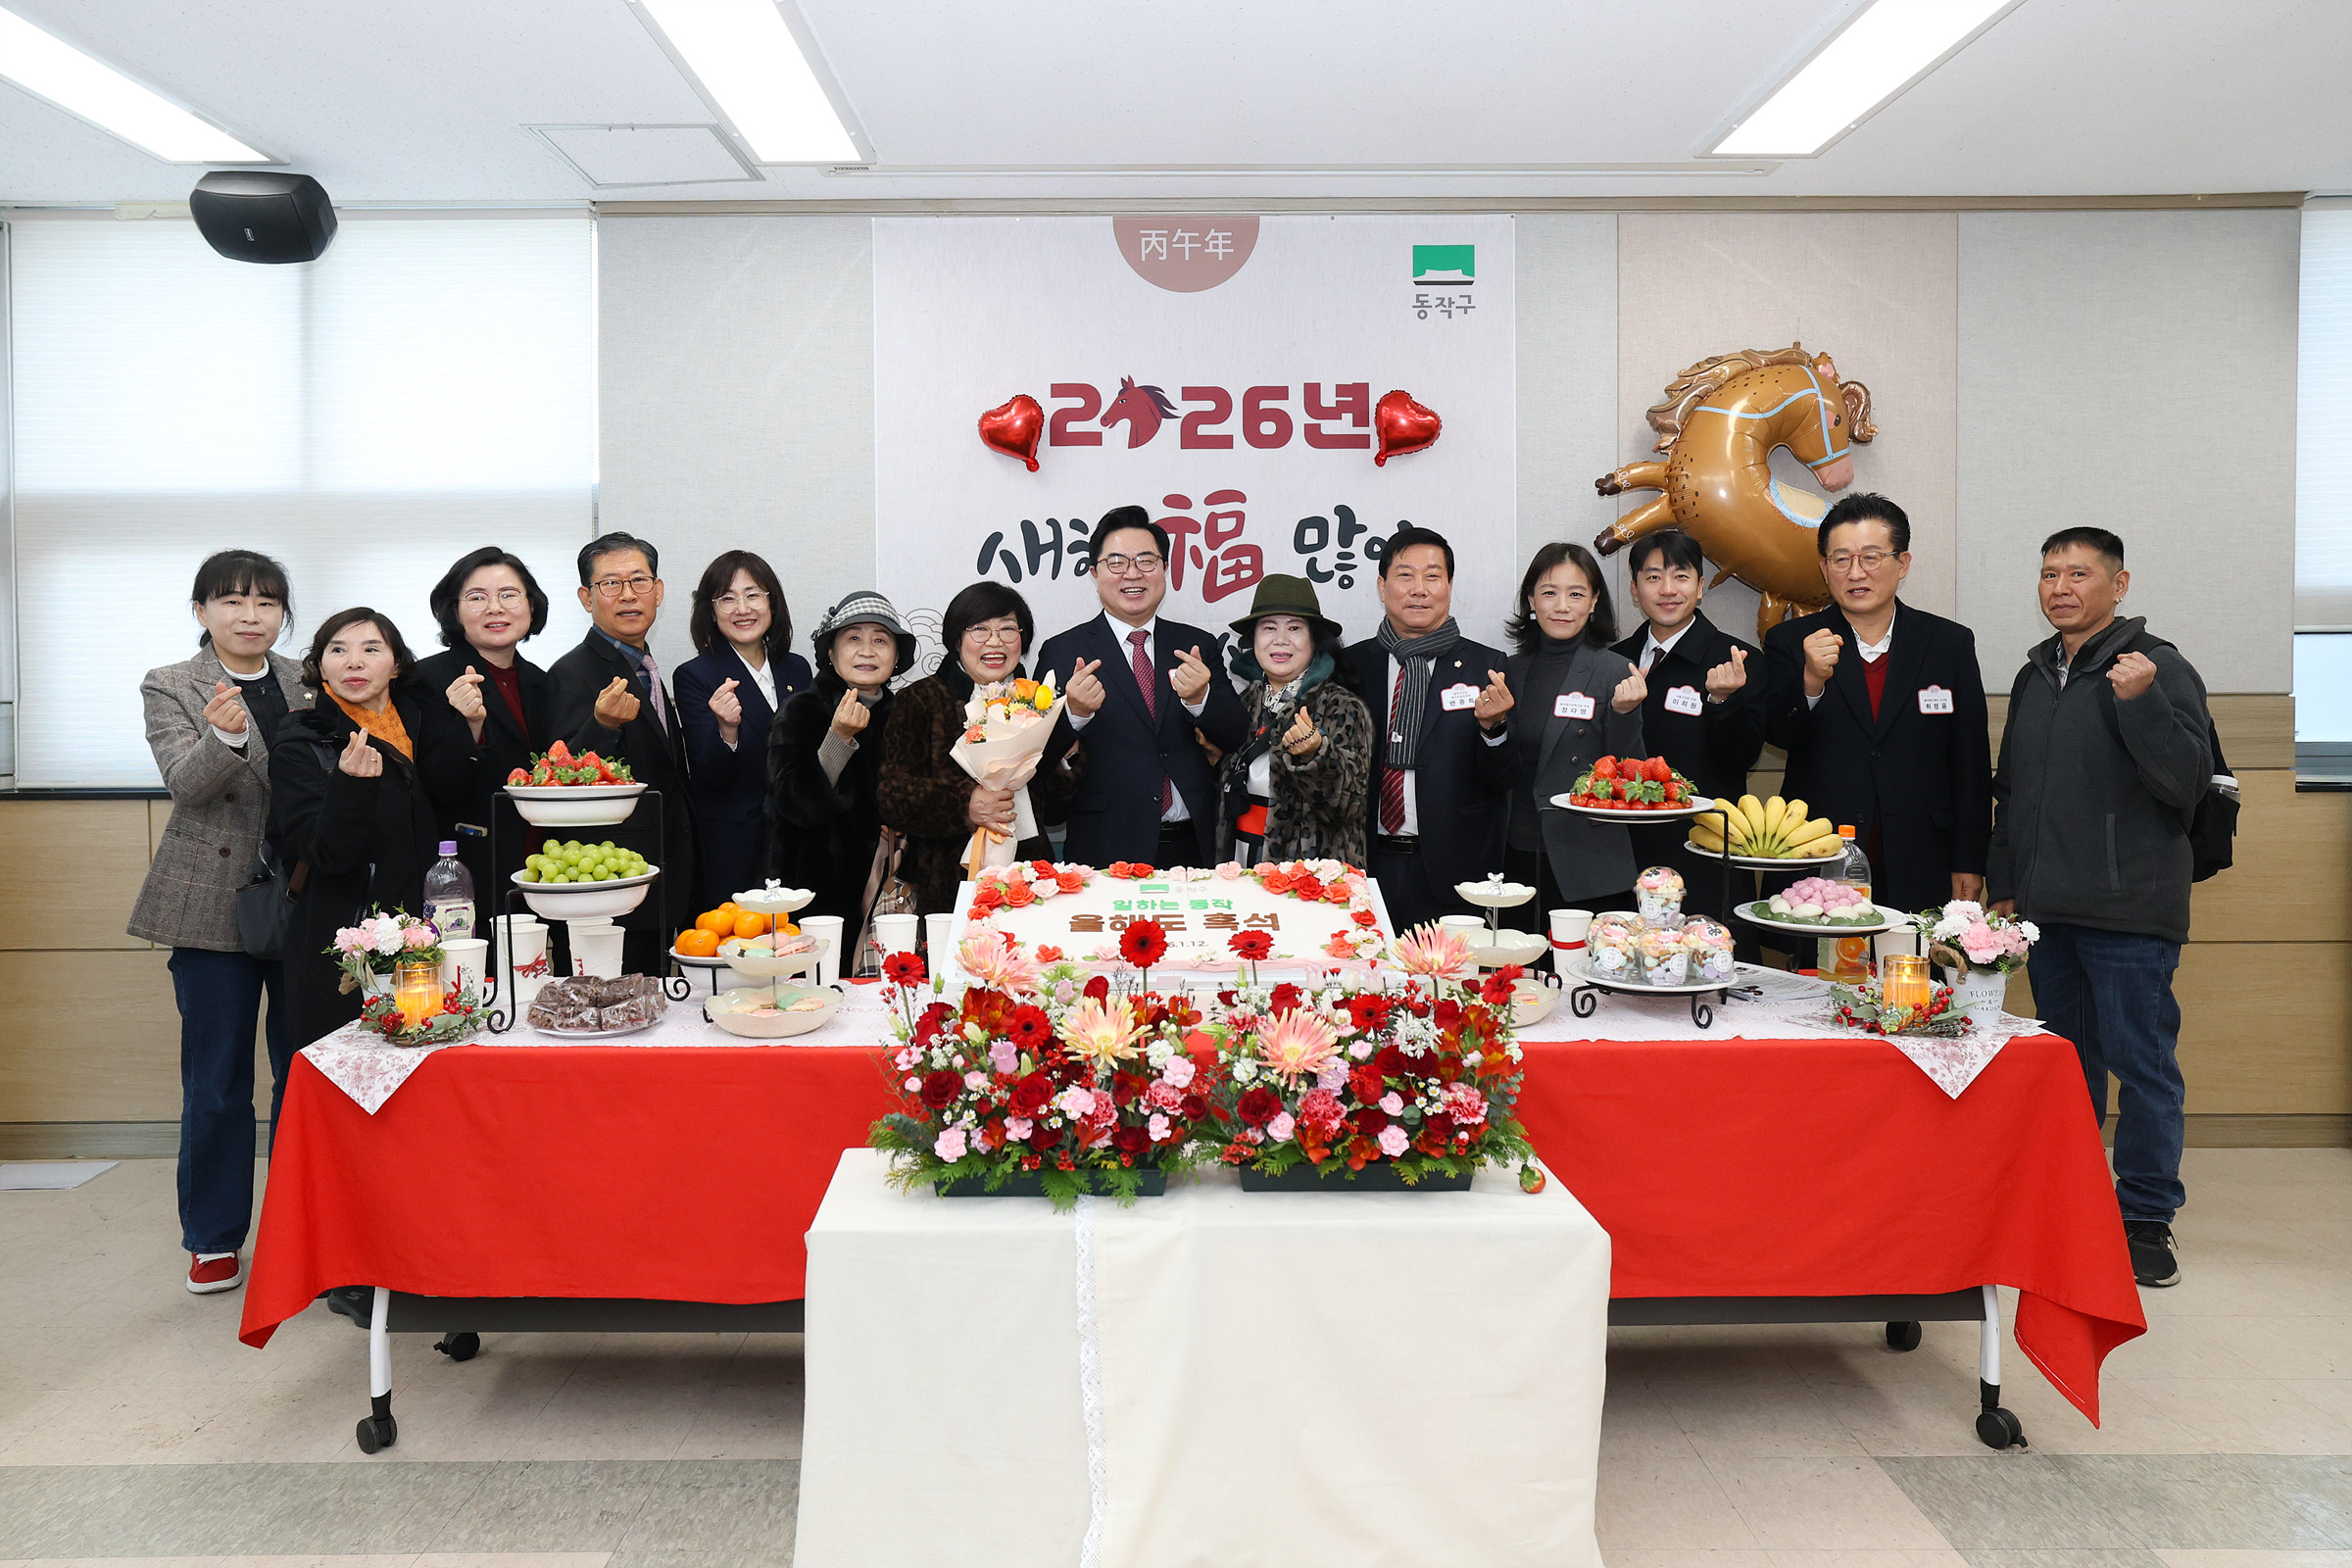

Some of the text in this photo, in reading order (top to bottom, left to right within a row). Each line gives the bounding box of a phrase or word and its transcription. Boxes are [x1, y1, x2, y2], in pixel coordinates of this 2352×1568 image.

[1139, 228, 1235, 262] 丙午年
[1412, 293, 1477, 320] 동작구
[1154, 489, 1264, 604] 福
[1112, 899, 1180, 911] 일하는
[1068, 911, 1281, 933] 올해도 흑석
